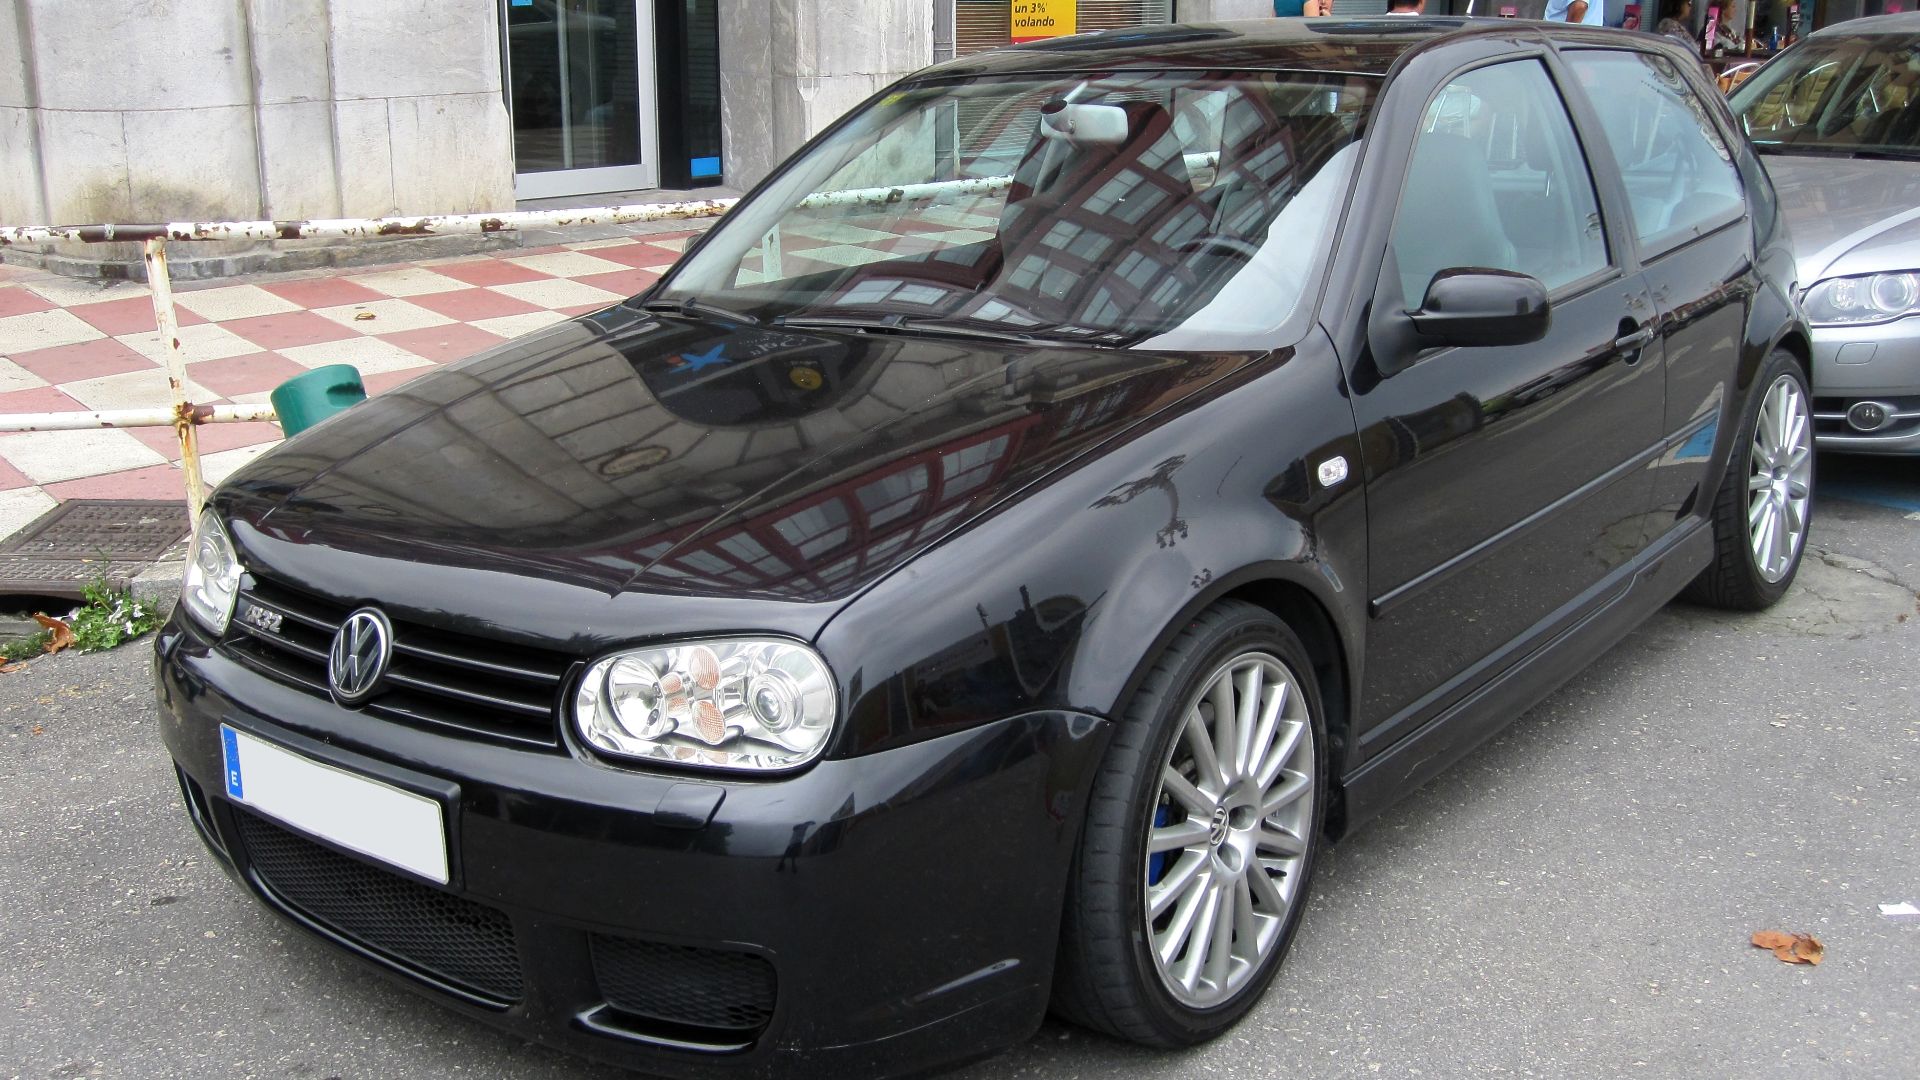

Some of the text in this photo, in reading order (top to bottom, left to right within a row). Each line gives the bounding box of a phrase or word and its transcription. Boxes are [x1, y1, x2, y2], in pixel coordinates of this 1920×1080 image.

[1015, 5, 1028, 13] un
[1015, 16, 1055, 27] volando
[245, 604, 282, 633] R32
[231, 770, 239, 786] E
